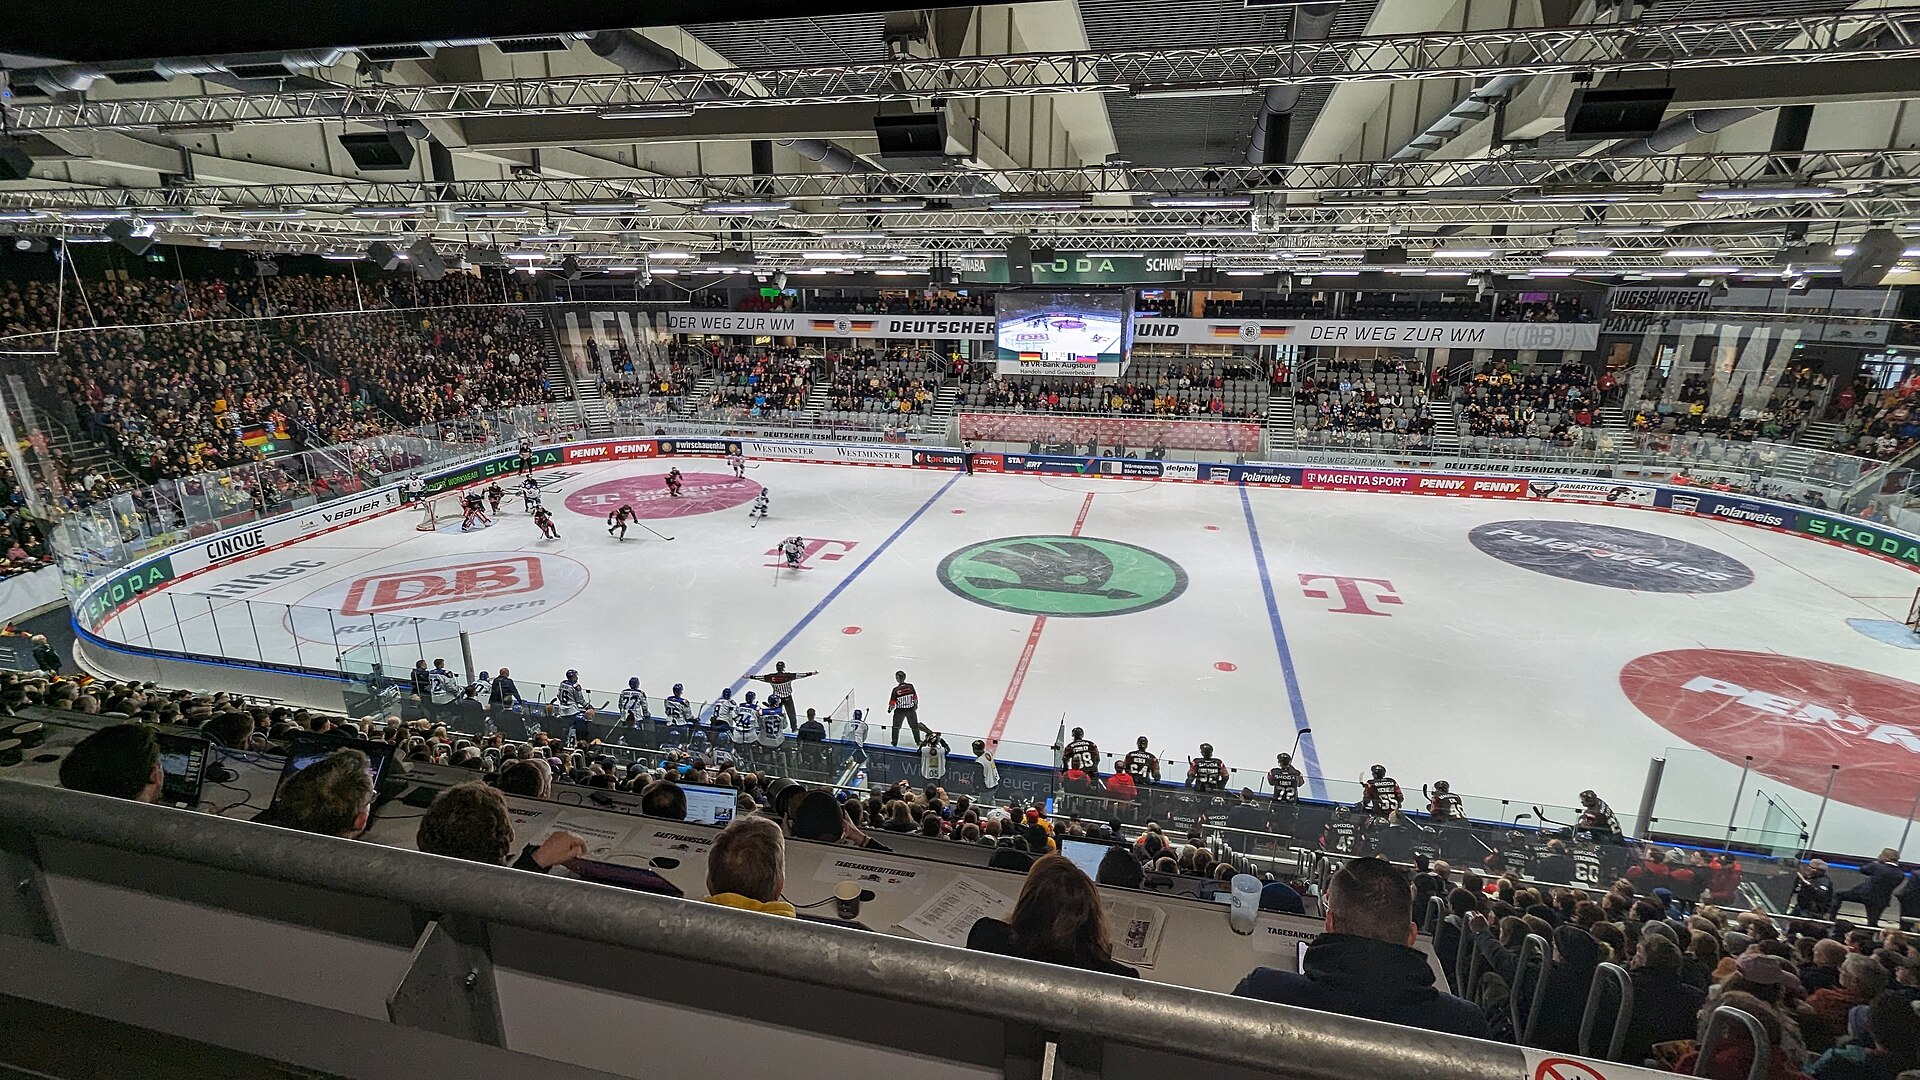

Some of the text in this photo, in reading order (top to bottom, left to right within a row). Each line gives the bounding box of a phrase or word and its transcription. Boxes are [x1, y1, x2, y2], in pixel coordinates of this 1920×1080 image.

[669, 317, 795, 331] DER WEG ZUR WM
[889, 320, 996, 334] DEUTSCHER
[1310, 325, 1486, 343] DER WEG ZUR WM
[1061, 362, 1097, 370] Augsburg
[763, 430, 811, 440] DEUTSCHER
[752, 443, 815, 455] WESTMINSTER
[836, 447, 901, 459] WESTMINSTER
[1326, 456, 1348, 465] WEG
[1165, 464, 1197, 473] delphis
[1444, 462, 1510, 473] DEUTSCHER
[1241, 472, 1291, 484] Polarweiss
[1317, 474, 1371, 486] MAGENTA
[1372, 476, 1408, 488] SPORT
[1559, 483, 1610, 493] FANARTIKEL
[1713, 504, 1784, 527] Polarweiss
[205, 529, 266, 560] CINQUE
[1485, 528, 1734, 581] Polarweiss
[437, 599, 547, 624] Bayern
[928, 769, 939, 778] 05
